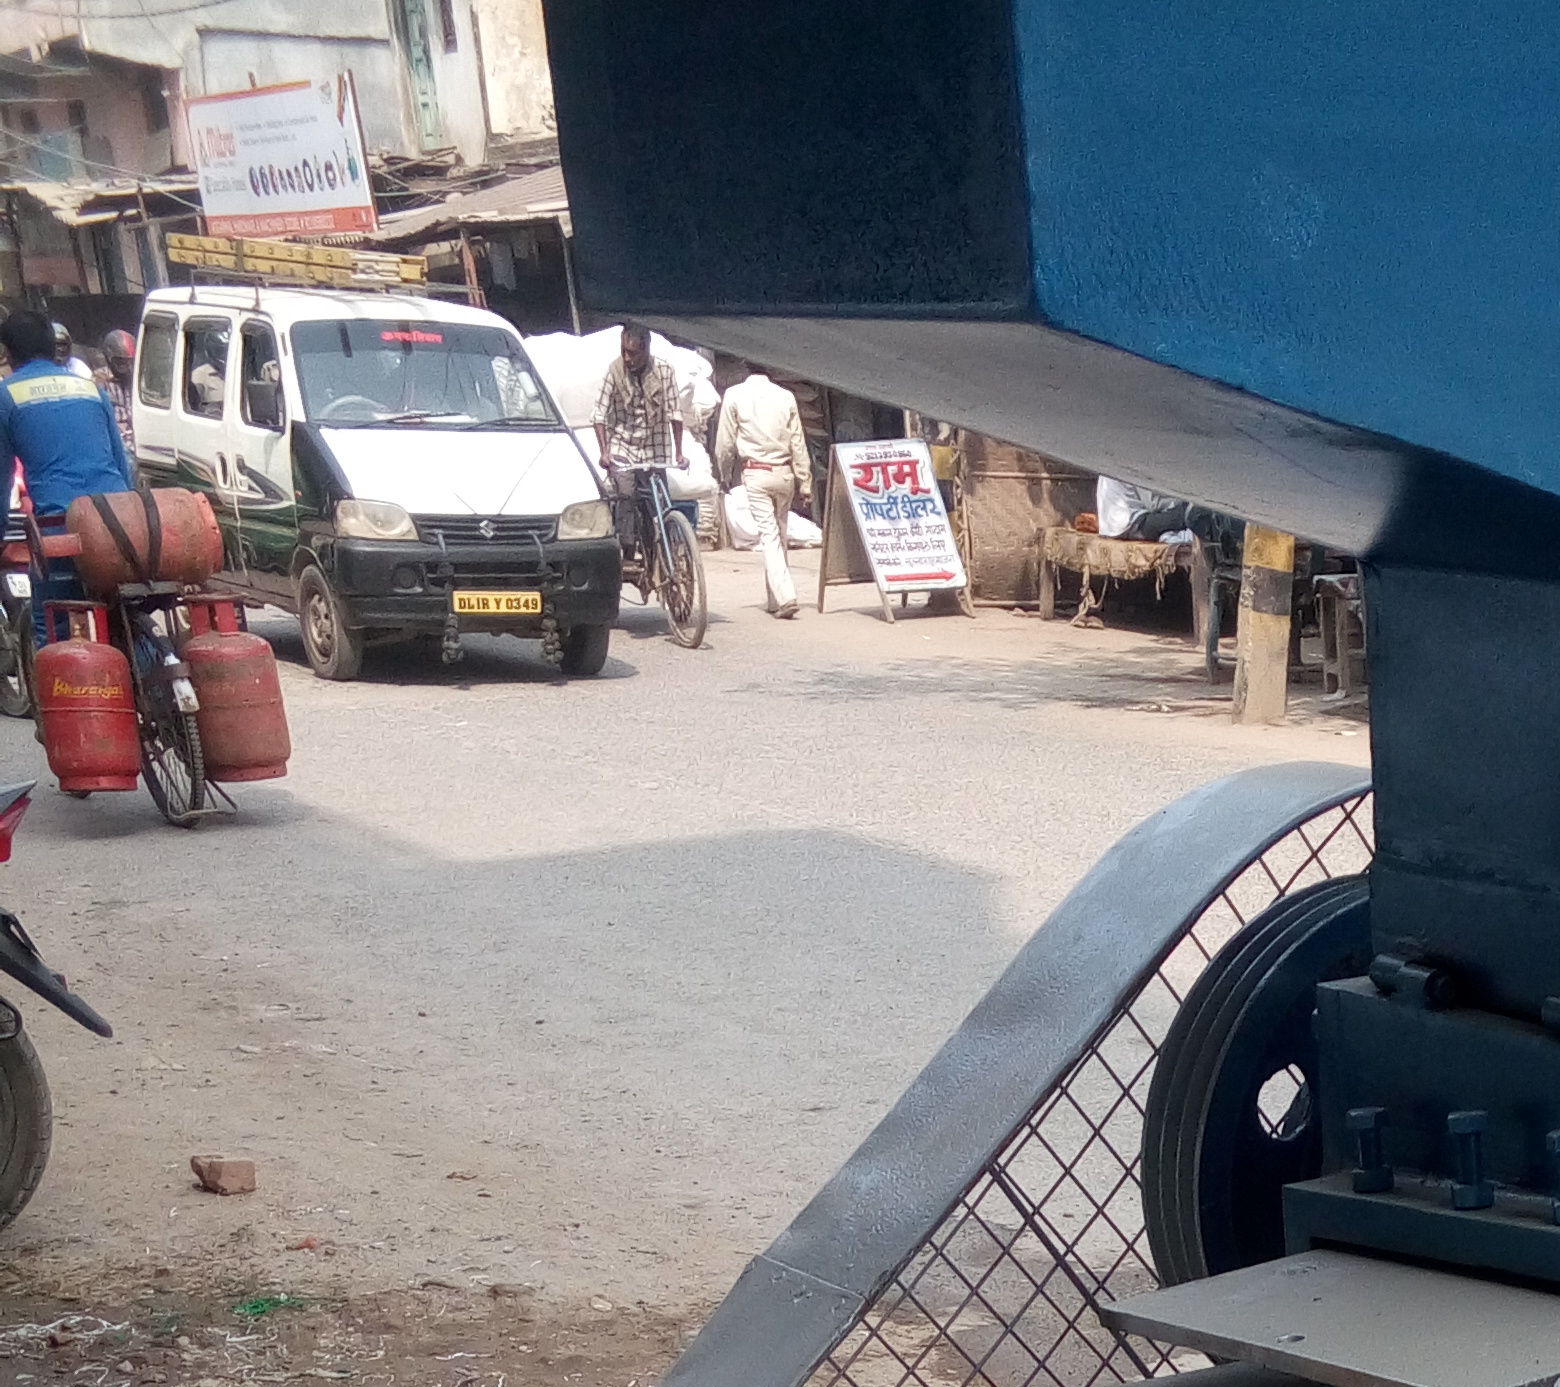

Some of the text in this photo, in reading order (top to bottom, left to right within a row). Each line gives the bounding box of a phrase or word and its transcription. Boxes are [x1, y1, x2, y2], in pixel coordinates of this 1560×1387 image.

[849, 459, 931, 496] रामू
[901, 493, 942, 519] डीलर
[506, 597, 538, 611] 0349
